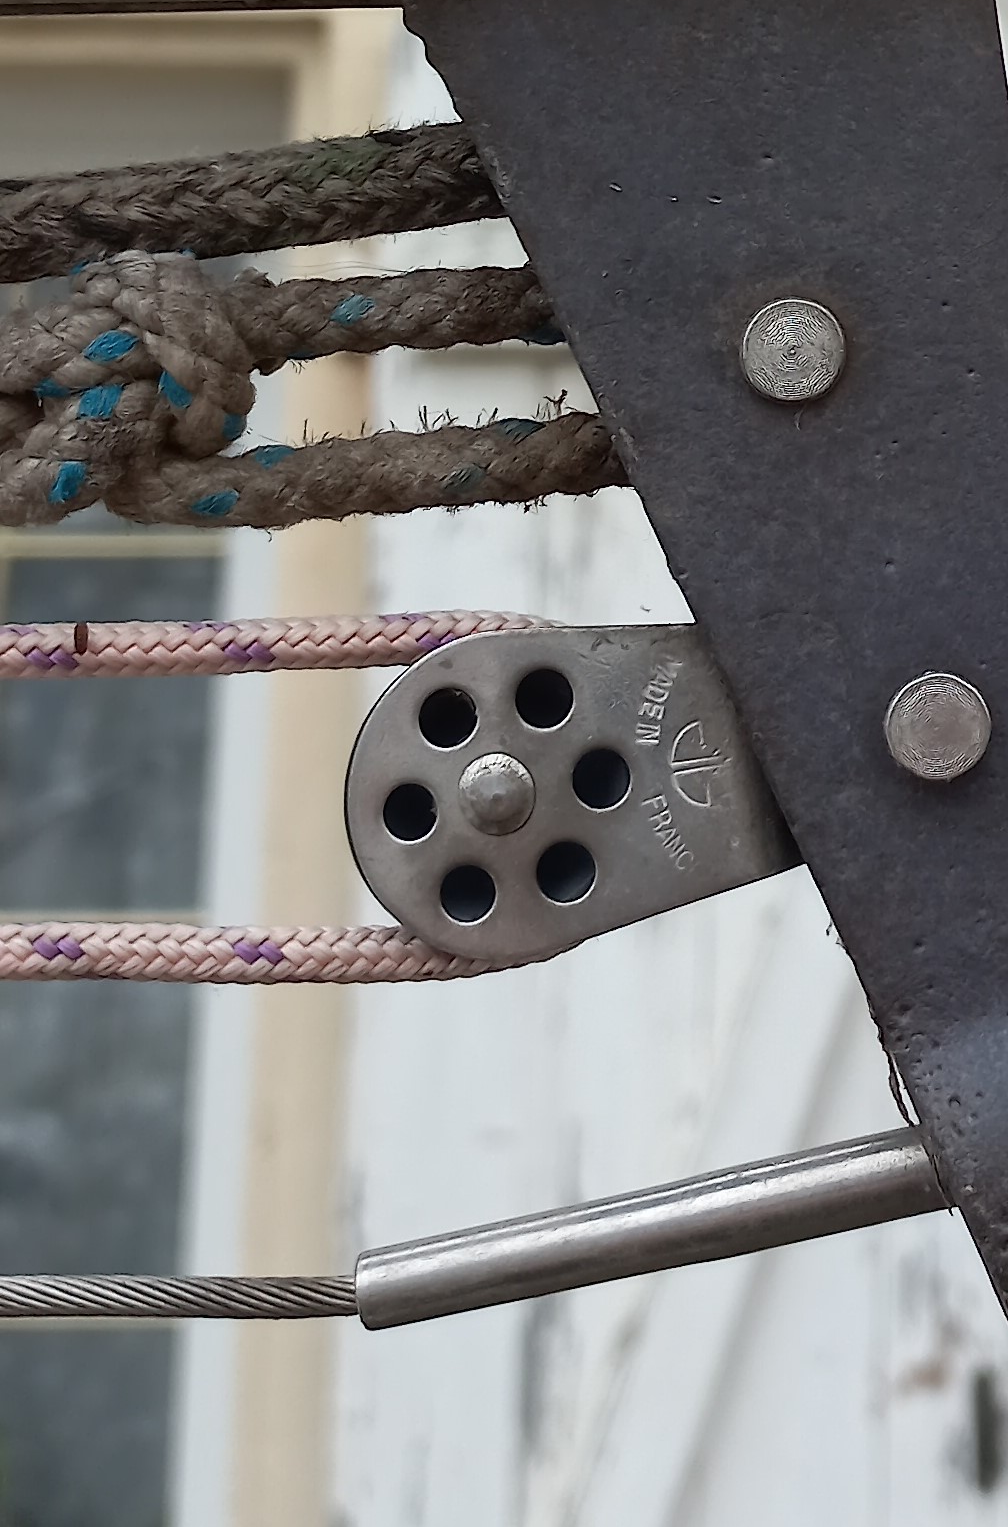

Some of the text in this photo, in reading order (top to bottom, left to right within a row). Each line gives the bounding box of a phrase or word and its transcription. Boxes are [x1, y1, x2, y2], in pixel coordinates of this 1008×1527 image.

[634, 656, 684, 746] MADE IN
[641, 793, 698, 872] FRANC
